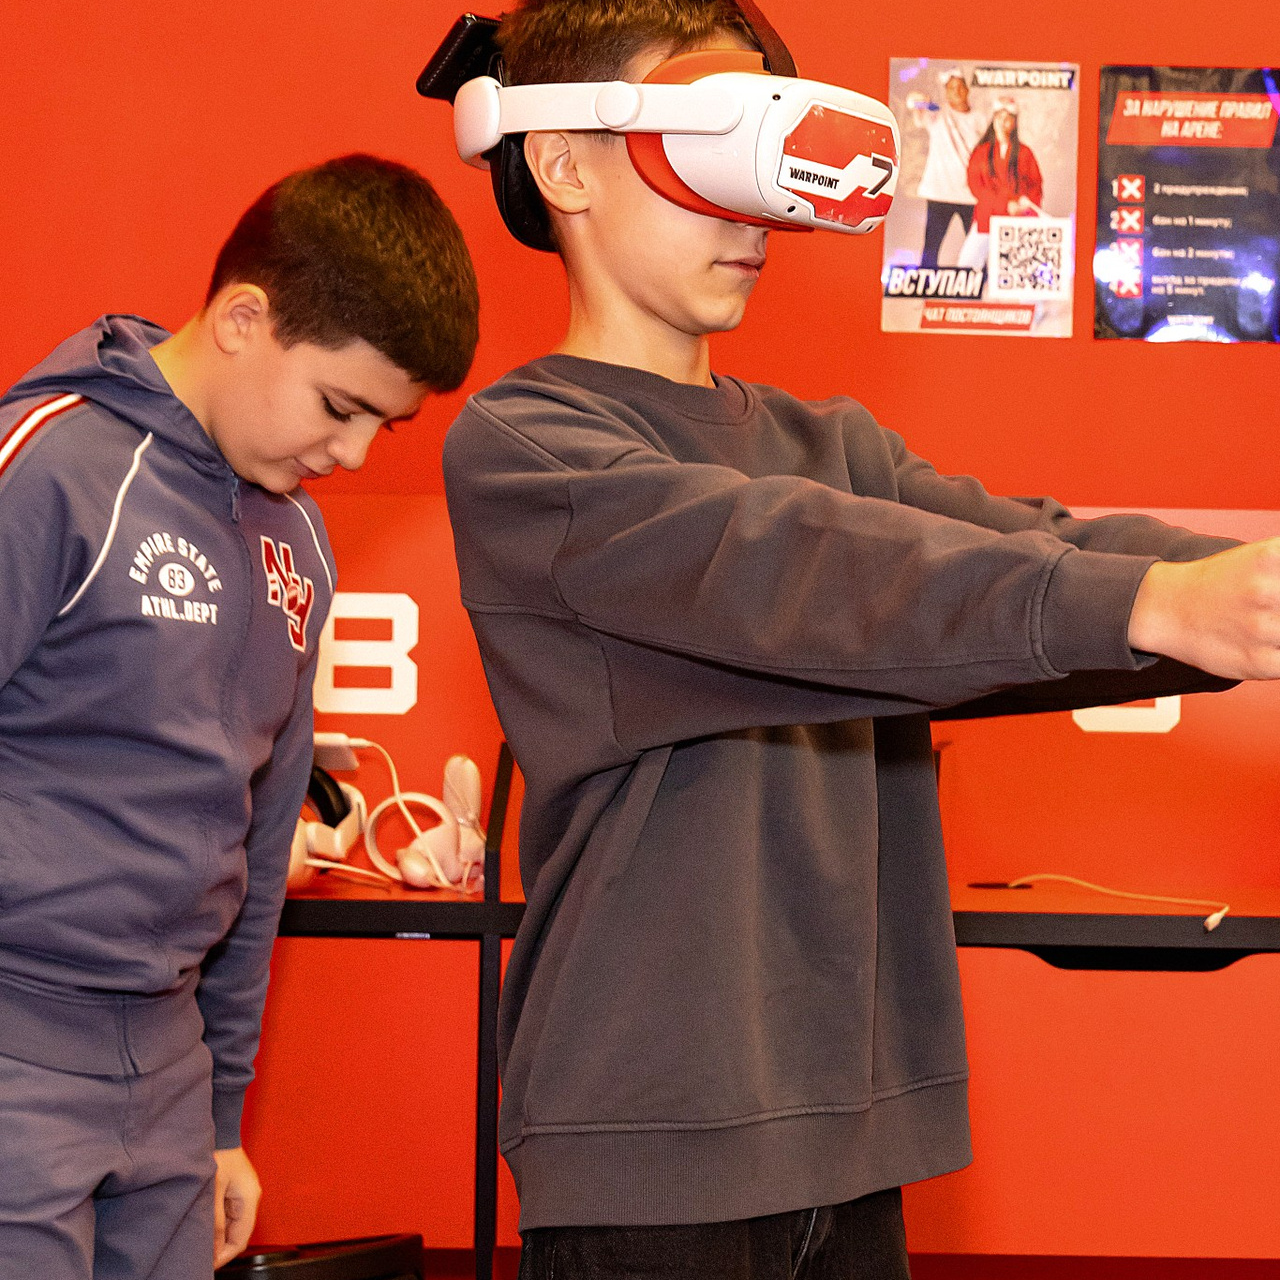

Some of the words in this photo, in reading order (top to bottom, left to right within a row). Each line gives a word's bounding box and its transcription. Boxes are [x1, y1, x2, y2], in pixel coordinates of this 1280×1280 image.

[975, 69, 1072, 88] WARPOINT
[789, 167, 840, 190] WARPOINT
[867, 155, 893, 196] 7
[888, 267, 983, 297] ВСТУПАЙ
[129, 532, 175, 585] EMPIRE
[177, 537, 223, 593] STATE
